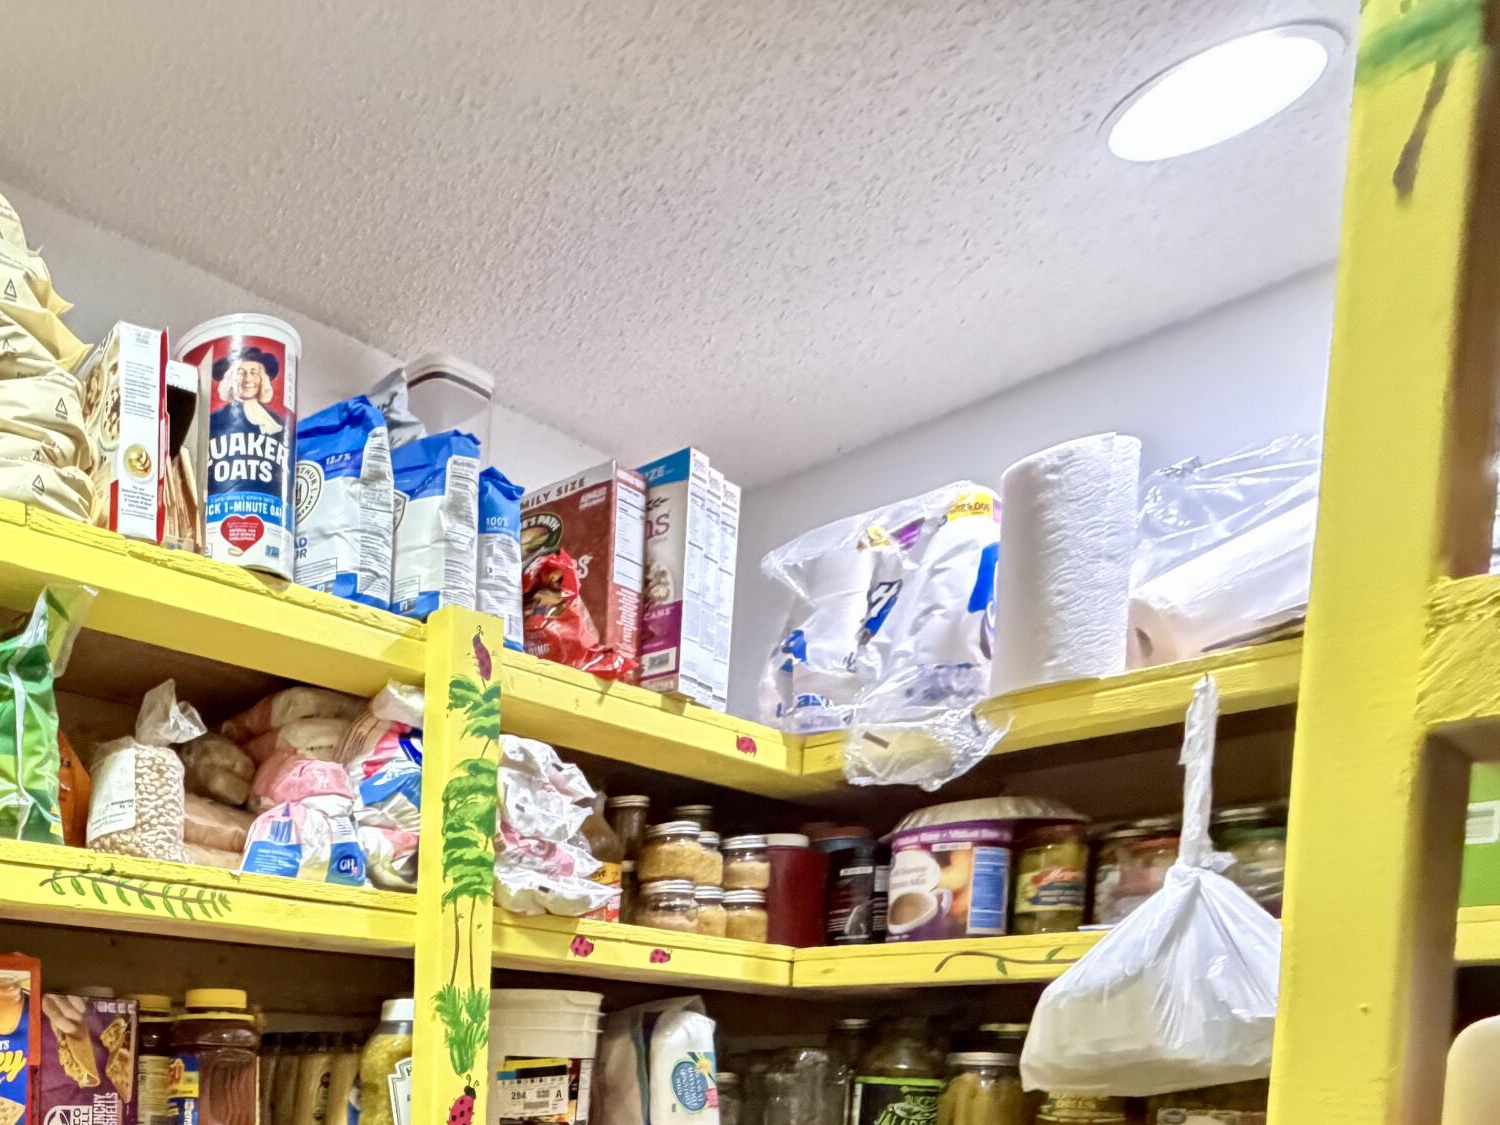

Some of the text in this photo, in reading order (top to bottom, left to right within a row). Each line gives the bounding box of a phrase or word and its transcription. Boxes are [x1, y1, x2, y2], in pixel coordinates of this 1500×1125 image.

[214, 460, 274, 484] OATS
[520, 478, 587, 511] MILY SIZE
[206, 501, 268, 515] ICK 1-MINUTE
